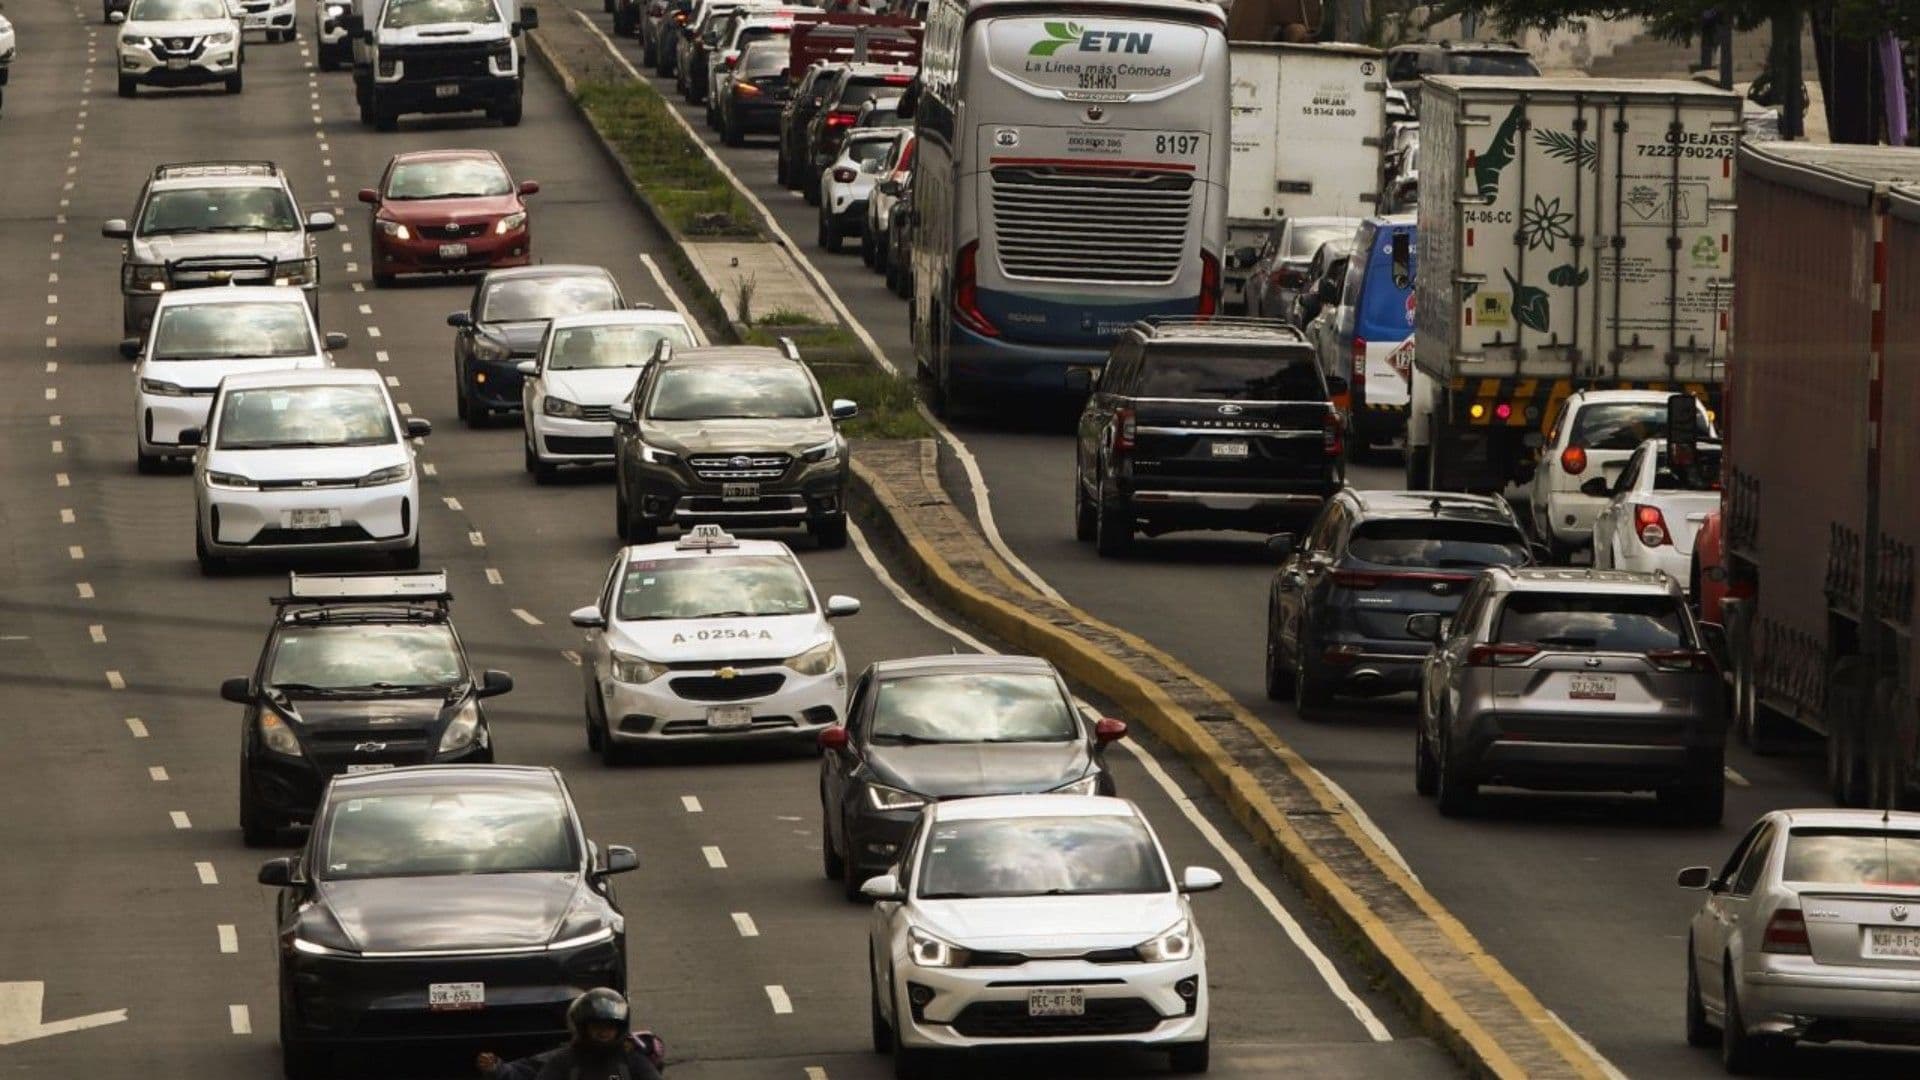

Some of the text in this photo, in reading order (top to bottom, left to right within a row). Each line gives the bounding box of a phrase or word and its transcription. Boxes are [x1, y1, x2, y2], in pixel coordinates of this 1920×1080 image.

[1078, 31, 1153, 54] ETN
[1025, 61, 1041, 72] La
[1045, 61, 1081, 74] Línea
[1118, 63, 1172, 78] Cómoda
[1312, 96, 1346, 106] QUEJAS
[1155, 135, 1200, 155] 8197
[1636, 144, 1735, 160] 7222790242
[696, 527, 719, 538] TAXI
[672, 629, 772, 644] A-0254-A
